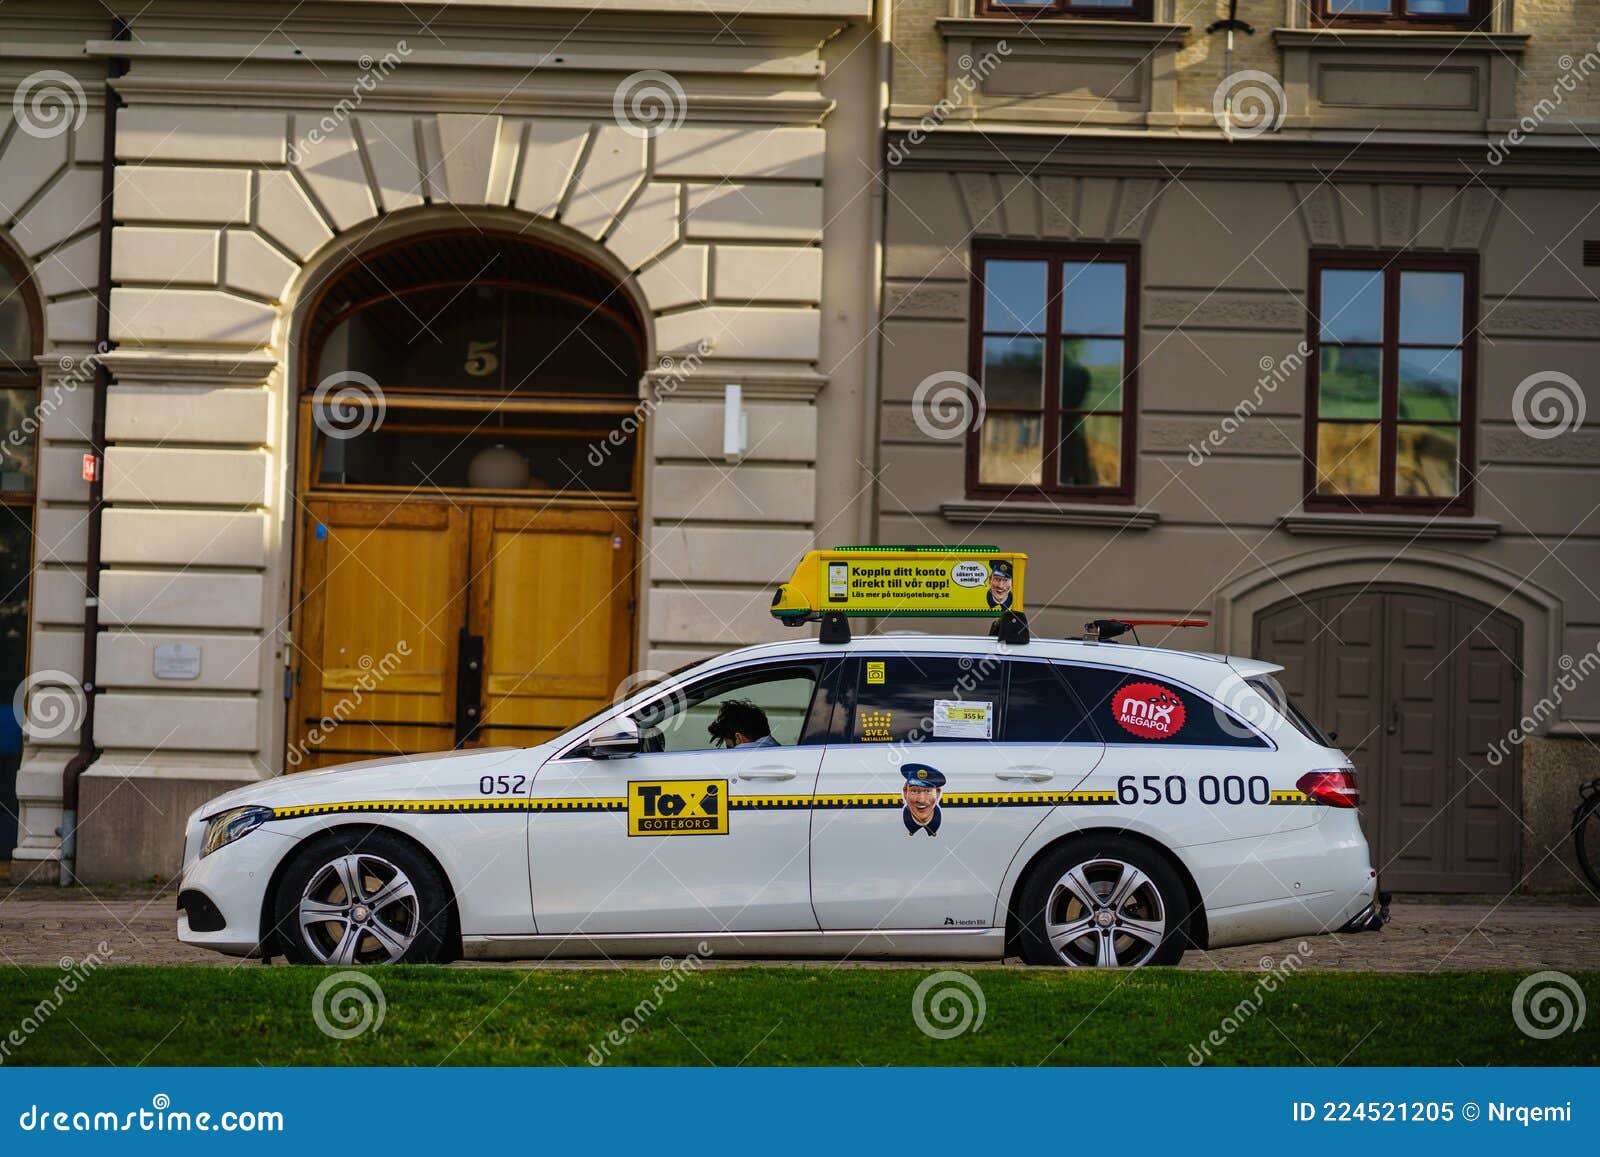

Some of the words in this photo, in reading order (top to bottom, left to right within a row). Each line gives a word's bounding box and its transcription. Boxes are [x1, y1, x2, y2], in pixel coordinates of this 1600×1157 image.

[464, 340, 498, 376] 5
[852, 567, 891, 578] Koppla
[894, 567, 912, 576] ditt
[915, 567, 946, 576] konto
[852, 579, 885, 588] direkt
[887, 579, 902, 588] till
[905, 578, 923, 588] vår
[925, 579, 950, 590] app!
[882, 591, 891, 599] på
[1121, 698, 1175, 724] mix
[865, 729, 889, 737] SVEA
[1120, 714, 1169, 733] MEGAPOL
[479, 775, 526, 795] 052
[1117, 775, 1187, 805] 650
[1198, 775, 1270, 805] 000
[638, 784, 719, 817] Taxi
